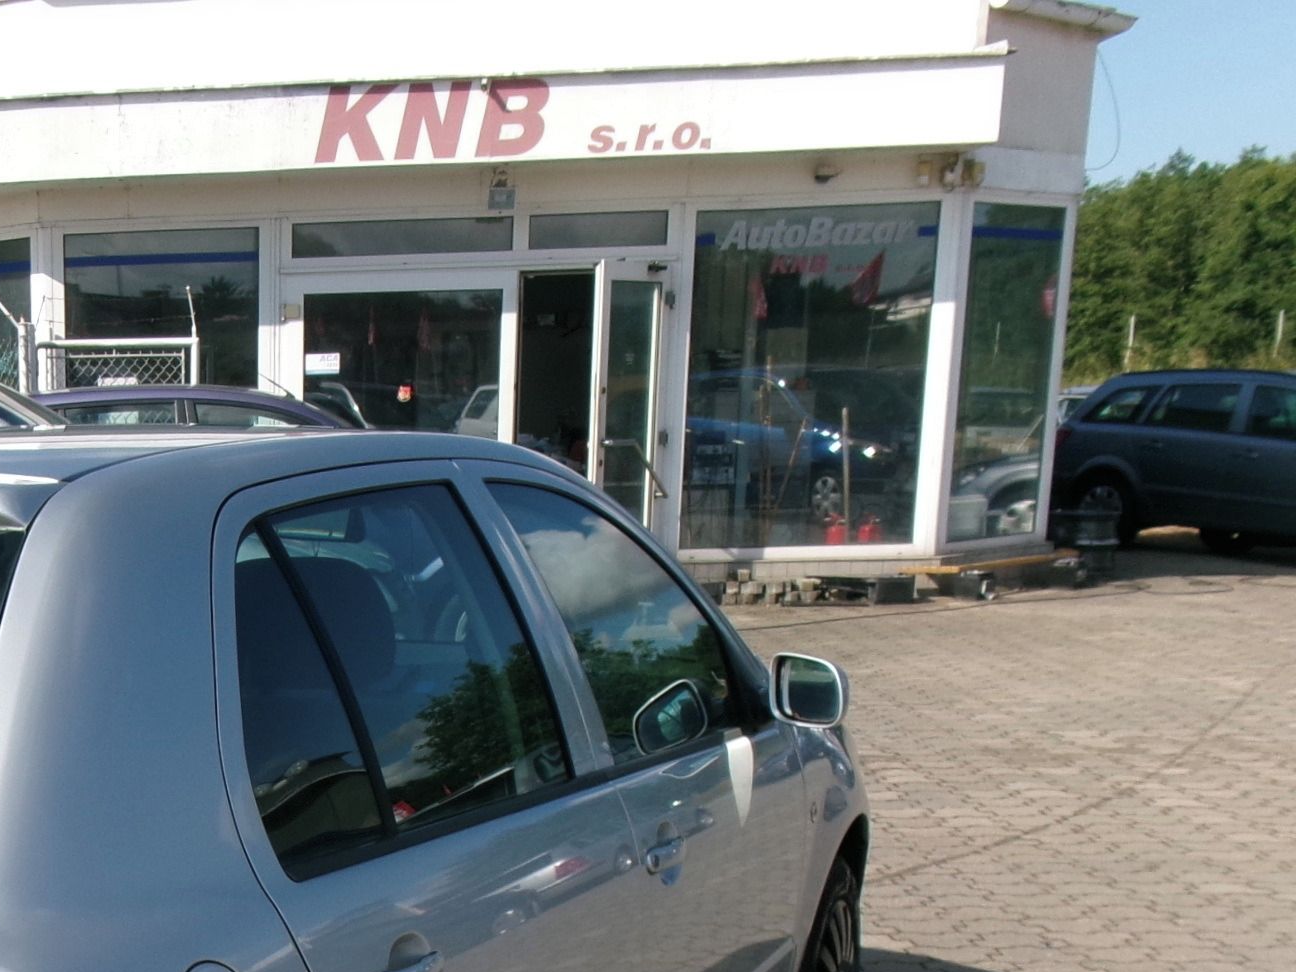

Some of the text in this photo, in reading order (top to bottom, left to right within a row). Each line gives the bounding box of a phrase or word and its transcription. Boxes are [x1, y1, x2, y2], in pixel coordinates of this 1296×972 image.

[314, 77, 712, 164] KNB s.r.o.
[719, 216, 915, 251] AutoBazar
[770, 254, 829, 274] KNB
